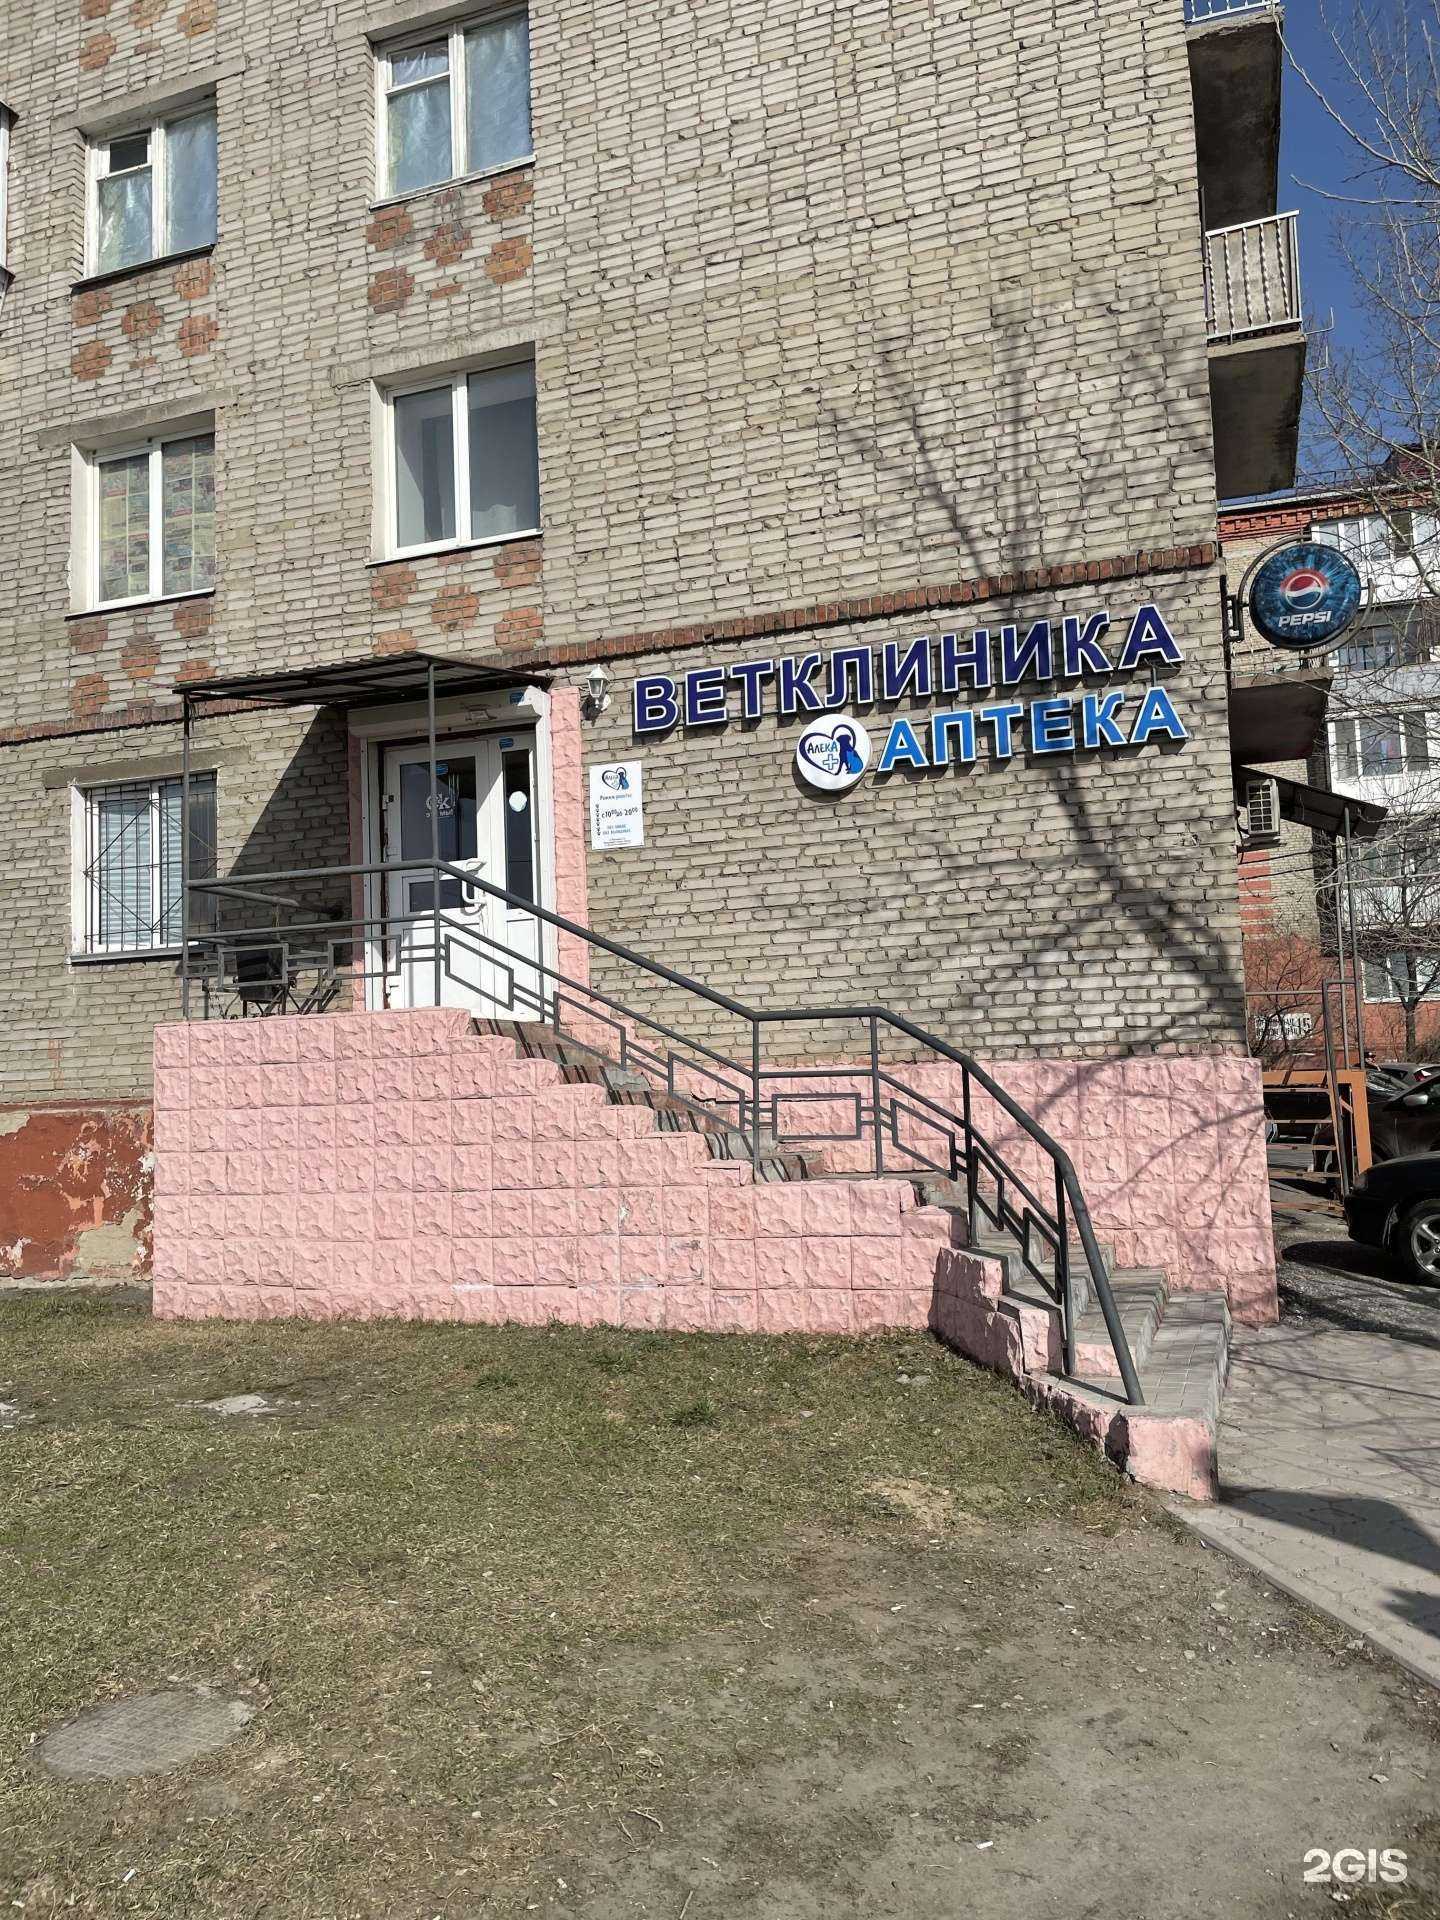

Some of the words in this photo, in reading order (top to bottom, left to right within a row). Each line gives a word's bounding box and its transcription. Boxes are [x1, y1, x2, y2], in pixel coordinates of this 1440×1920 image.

[1278, 610, 1332, 628] PEPSI
[633, 603, 1183, 733] ВЕТКЛИНИКА
[877, 686, 1188, 773] АПТЕКА
